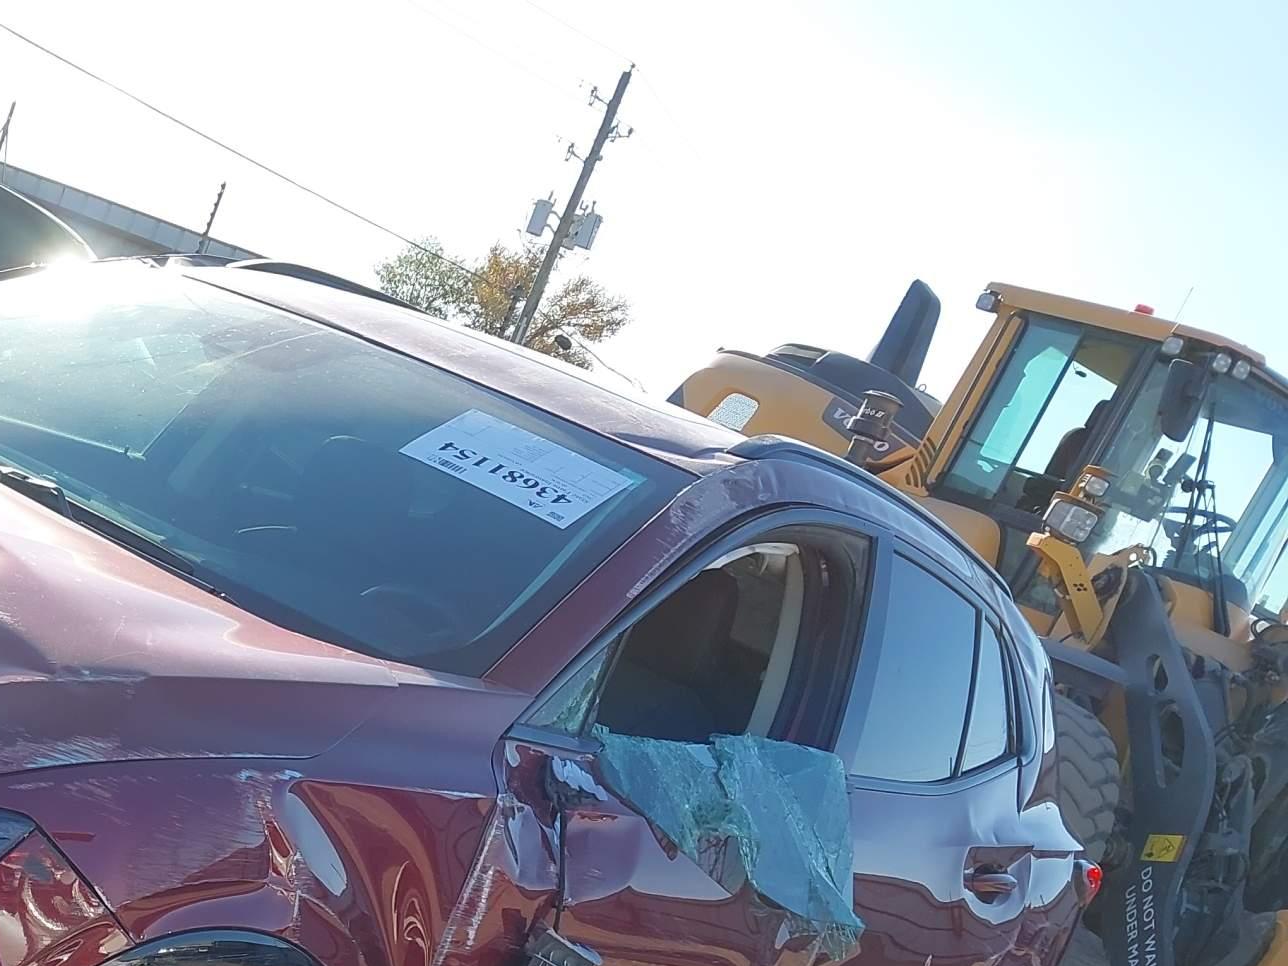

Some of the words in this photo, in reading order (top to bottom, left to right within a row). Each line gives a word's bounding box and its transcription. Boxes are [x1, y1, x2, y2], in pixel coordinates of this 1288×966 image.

[437, 441, 572, 504] 43681154
[1141, 866, 1153, 892] DO
[1125, 885, 1138, 943] UNDER
[1143, 895, 1155, 931] NOT
